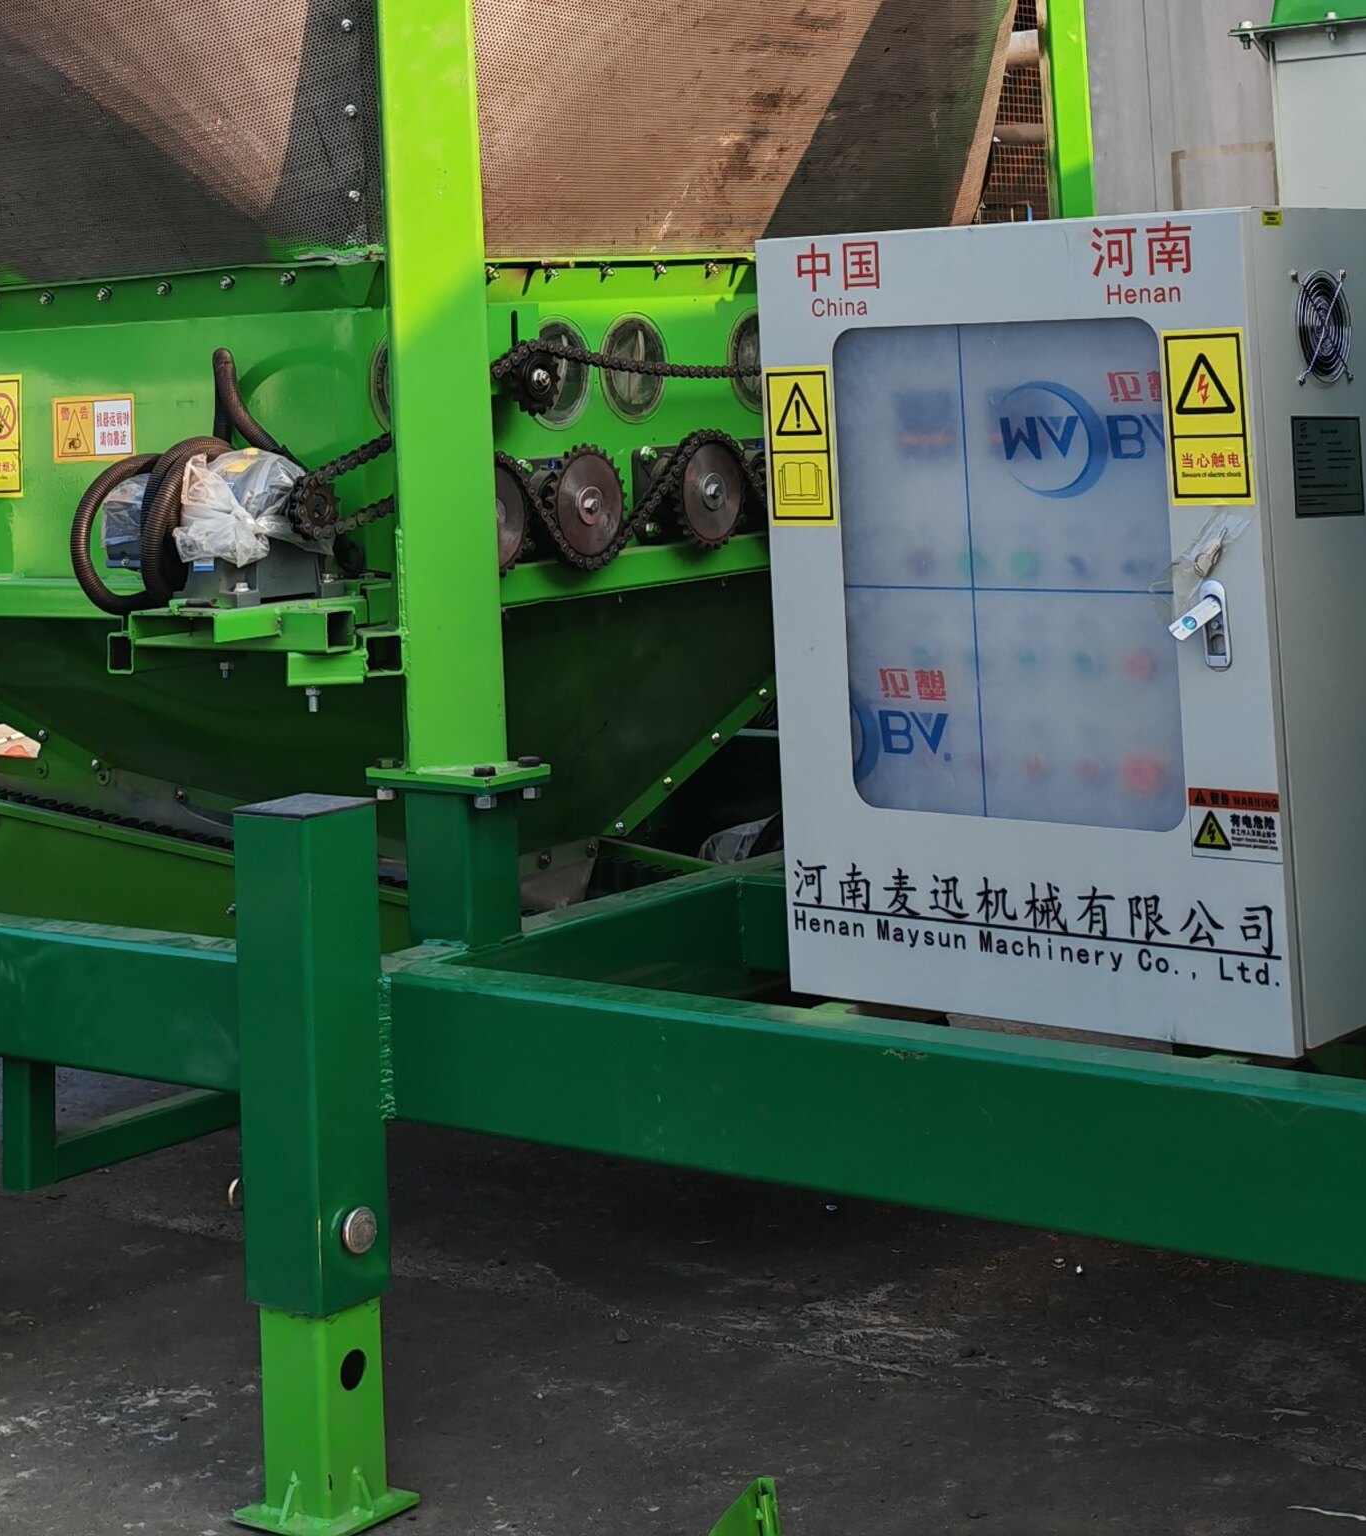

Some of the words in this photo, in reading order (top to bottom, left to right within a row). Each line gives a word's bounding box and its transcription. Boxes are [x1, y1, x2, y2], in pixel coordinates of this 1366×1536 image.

[1091, 221, 1191, 277] 河南
[797, 240, 880, 292] 中国
[1107, 284, 1181, 305] Henan
[811, 297, 868, 317] China
[1181, 452, 1242, 468] 当心触电
[1232, 795, 1279, 810] WARNING
[1230, 813, 1275, 830] 有电危险
[793, 859, 1274, 956] 河南麦迅机械有限公司
[794, 909, 865, 939] Henan
[876, 918, 967, 950] Maysun
[978, 929, 1123, 972] Machinery
[1138, 948, 1197, 980] Co.,
[1219, 956, 1280, 987] Ltd.
